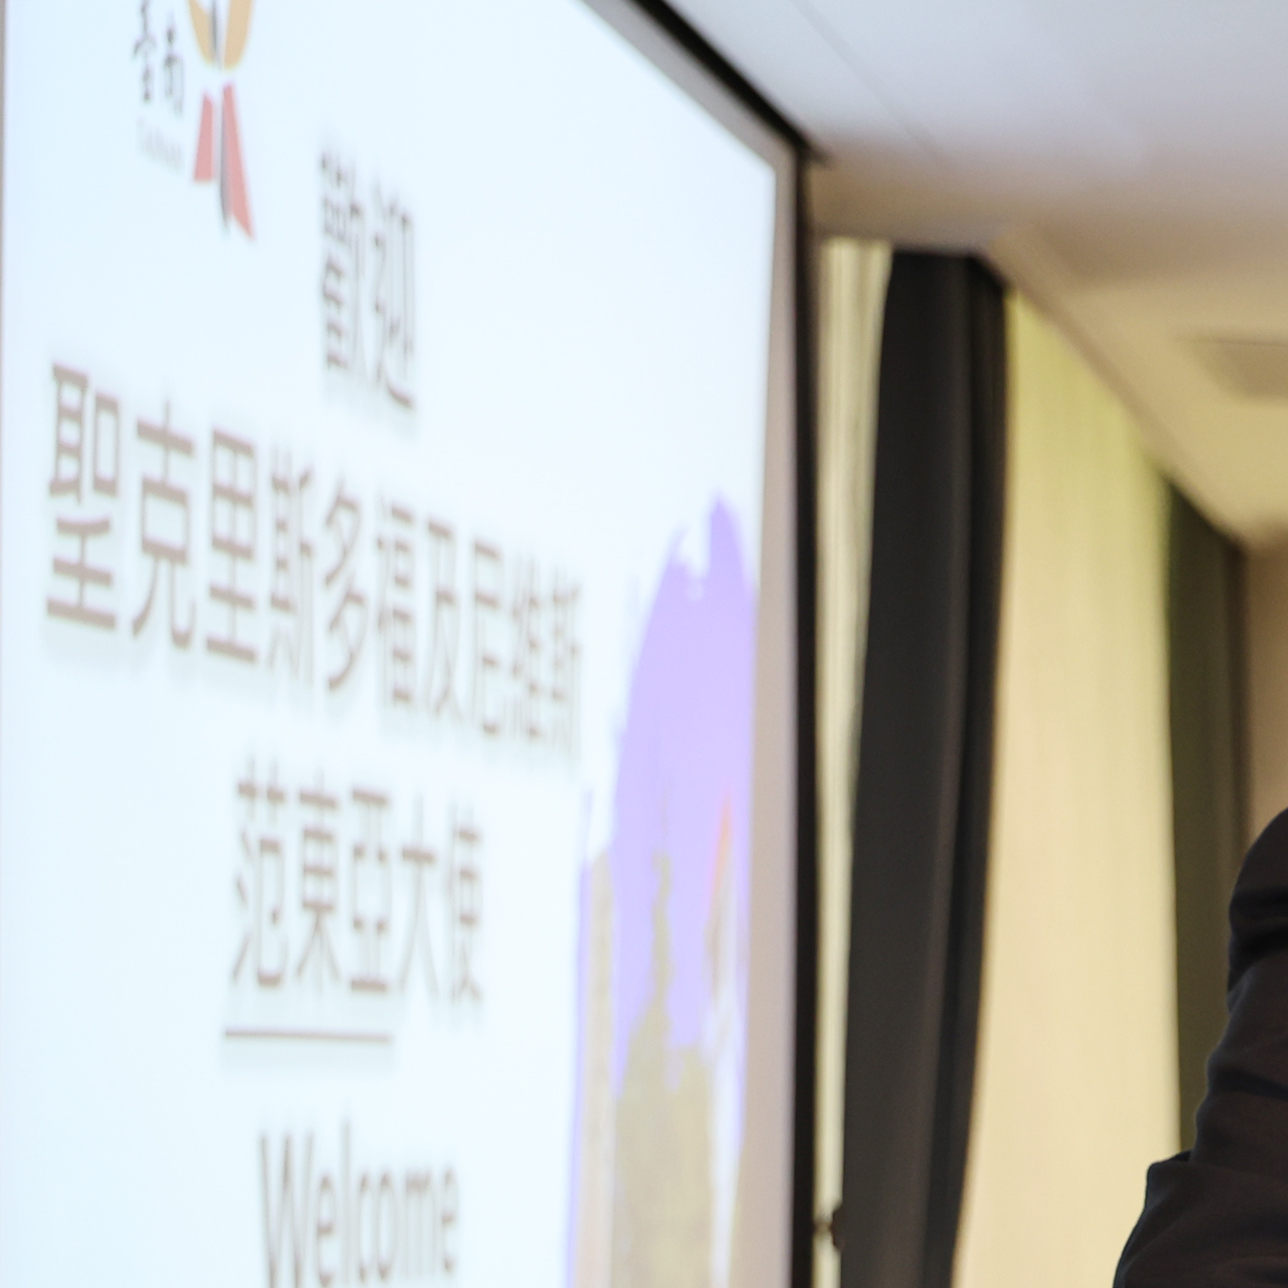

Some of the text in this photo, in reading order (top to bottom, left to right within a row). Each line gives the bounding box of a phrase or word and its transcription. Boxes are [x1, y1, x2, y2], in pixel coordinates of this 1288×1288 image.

[320, 147, 415, 410] 歡迎
[46, 362, 582, 750] 聖克里斯多福及尼維斯
[232, 755, 482, 1008] 范東亞大使
